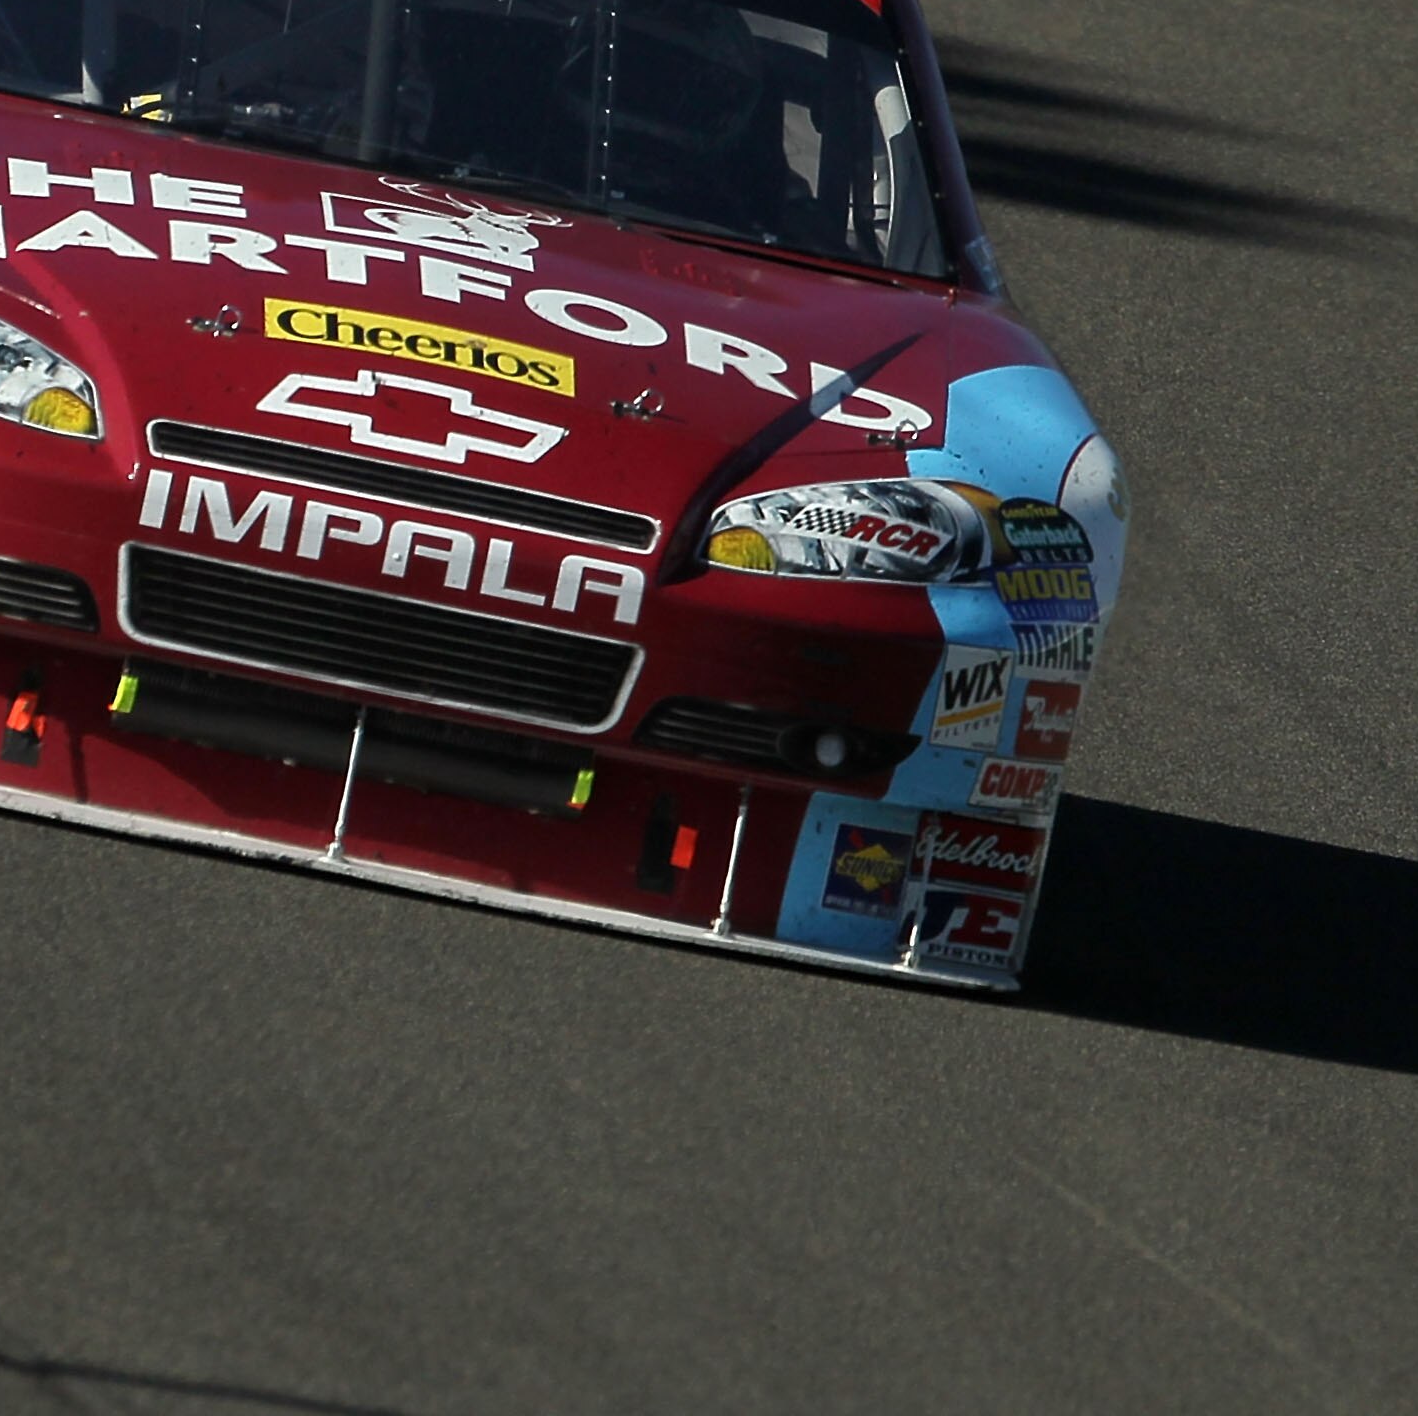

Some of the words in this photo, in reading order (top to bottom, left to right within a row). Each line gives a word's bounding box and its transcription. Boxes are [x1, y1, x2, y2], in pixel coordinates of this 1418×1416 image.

[277, 308, 559, 387] Cheerios
[139, 469, 645, 624] IMPALA
[844, 515, 940, 557] RCR
[1022, 548, 1089, 562] BELTS
[996, 568, 1092, 601] MOOG
[1014, 624, 1094, 670] MAHLE
[944, 656, 1008, 710] WIX
[934, 715, 999, 738] FILTERS
[980, 762, 1046, 798] COMP
